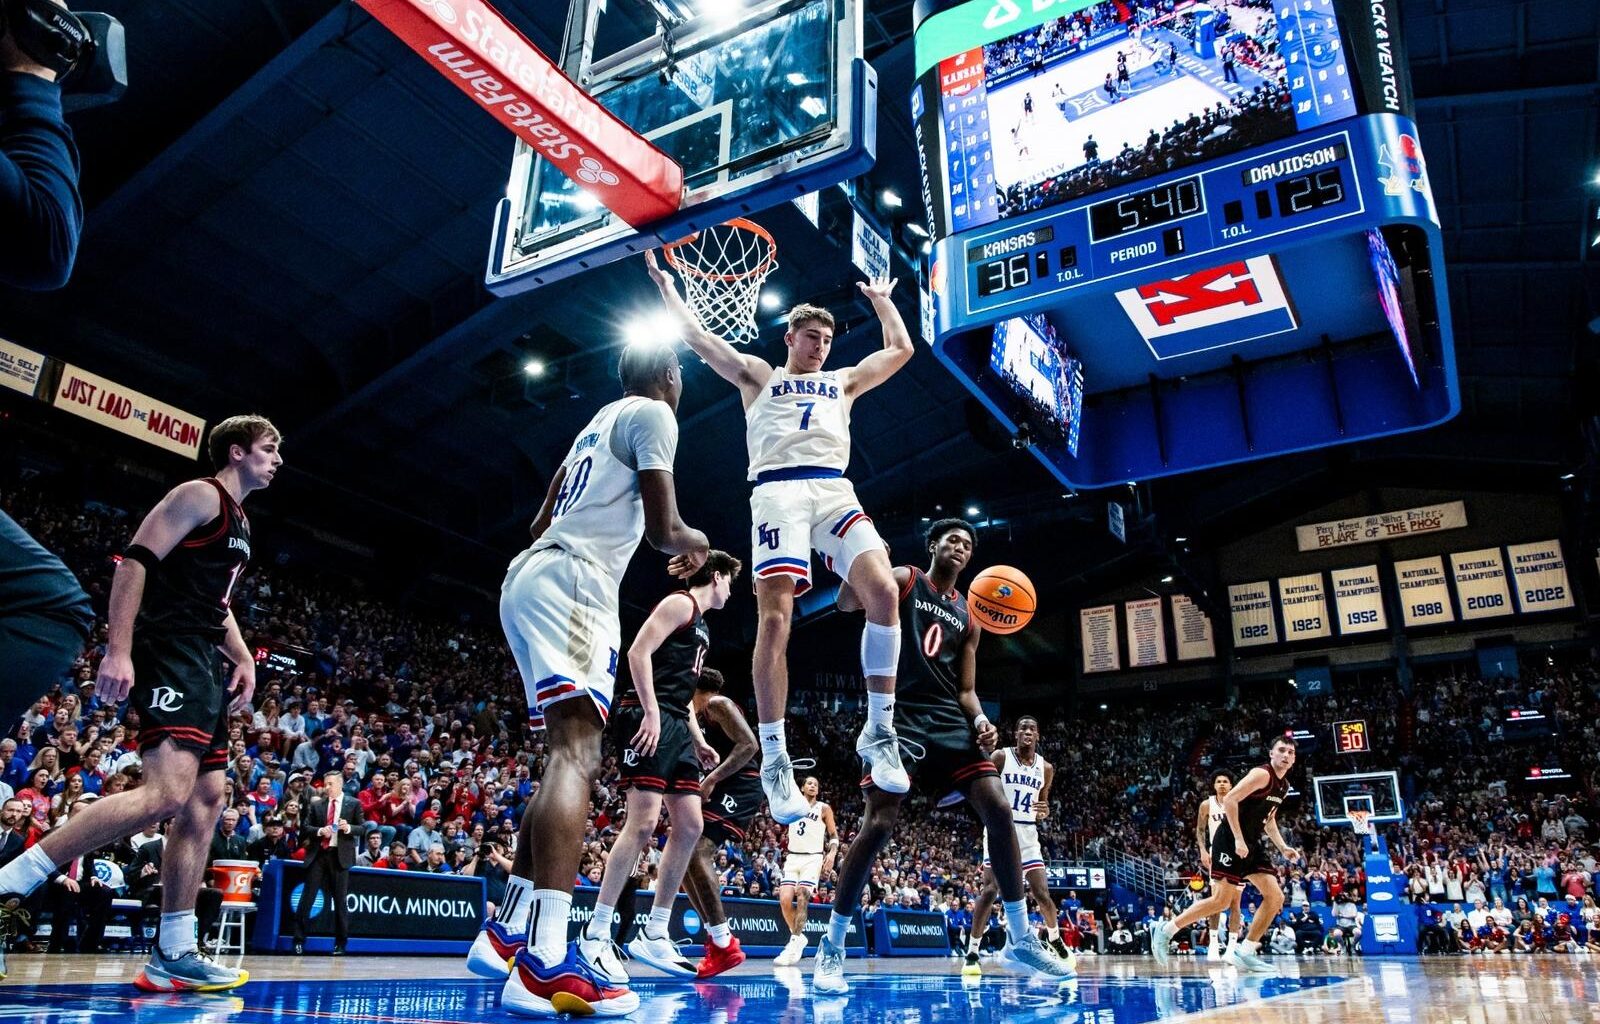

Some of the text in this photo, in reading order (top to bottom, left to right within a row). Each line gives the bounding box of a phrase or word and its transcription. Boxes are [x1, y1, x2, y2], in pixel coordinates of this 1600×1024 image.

[1375, 28, 1389, 39] &
[943, 63, 982, 86] KANSAS
[1377, 42, 1400, 110] VEATCH
[953, 160, 959, 171] 7
[1250, 147, 1336, 184] DAVIDSON
[1291, 170, 1343, 212] 25
[1118, 180, 1199, 231] 5:40
[1176, 230, 1183, 250] 1
[1221, 226, 1252, 239] T.O.L.
[984, 231, 1036, 259] KANSAS
[1110, 241, 1158, 264] PERIOD
[988, 255, 1028, 293] 36
[1056, 268, 1084, 282] T.O.L.
[17, 358, 39, 372] SELF
[770, 380, 838, 399] KANSAS
[61, 376, 200, 448] JUST LOAD THE WAGON
[796, 402, 816, 431] 7
[757, 522, 780, 550] KU
[1318, 529, 1359, 547] BEWARE
[1365, 527, 1380, 538] OF
[1516, 550, 1557, 563] NATIONAL
[1402, 567, 1439, 578] NATIONAL
[1459, 559, 1498, 571] NATIONAL
[1514, 560, 1564, 574] CHAMPIONS
[1339, 576, 1375, 587] NATIONAL
[1400, 577, 1446, 590] CHAMPIONS
[1456, 569, 1504, 582] CHAMPIONS
[1285, 584, 1320, 595] NATIONAL
[1336, 586, 1380, 598] CHAMPIONS
[1525, 586, 1565, 603] 2022
[1283, 593, 1326, 606] CHAMPIONS
[1467, 593, 1504, 610] 2008
[914, 598, 965, 633] DAVIDSON
[1411, 601, 1443, 617] 1988
[1292, 617, 1322, 632] 1923
[1347, 610, 1378, 625] 1952
[1240, 624, 1269, 639] 1922
[924, 623, 942, 658] 0
[1308, 680, 1321, 691] 22
[148, 686, 184, 712] DC
[1341, 723, 1363, 733] 5:40
[1340, 732, 1363, 750] 30
[624, 749, 640, 767] DC
[1004, 773, 1042, 790] KANSAS
[720, 793, 738, 813] DC
[1012, 789, 1033, 814] 14
[796, 821, 807, 836] 3
[1076, 875, 1087, 886] 25
[405, 896, 476, 919] MINOLTA
[741, 917, 779, 932] MINOLTA
[899, 924, 945, 937] KONICA MINOLTA
